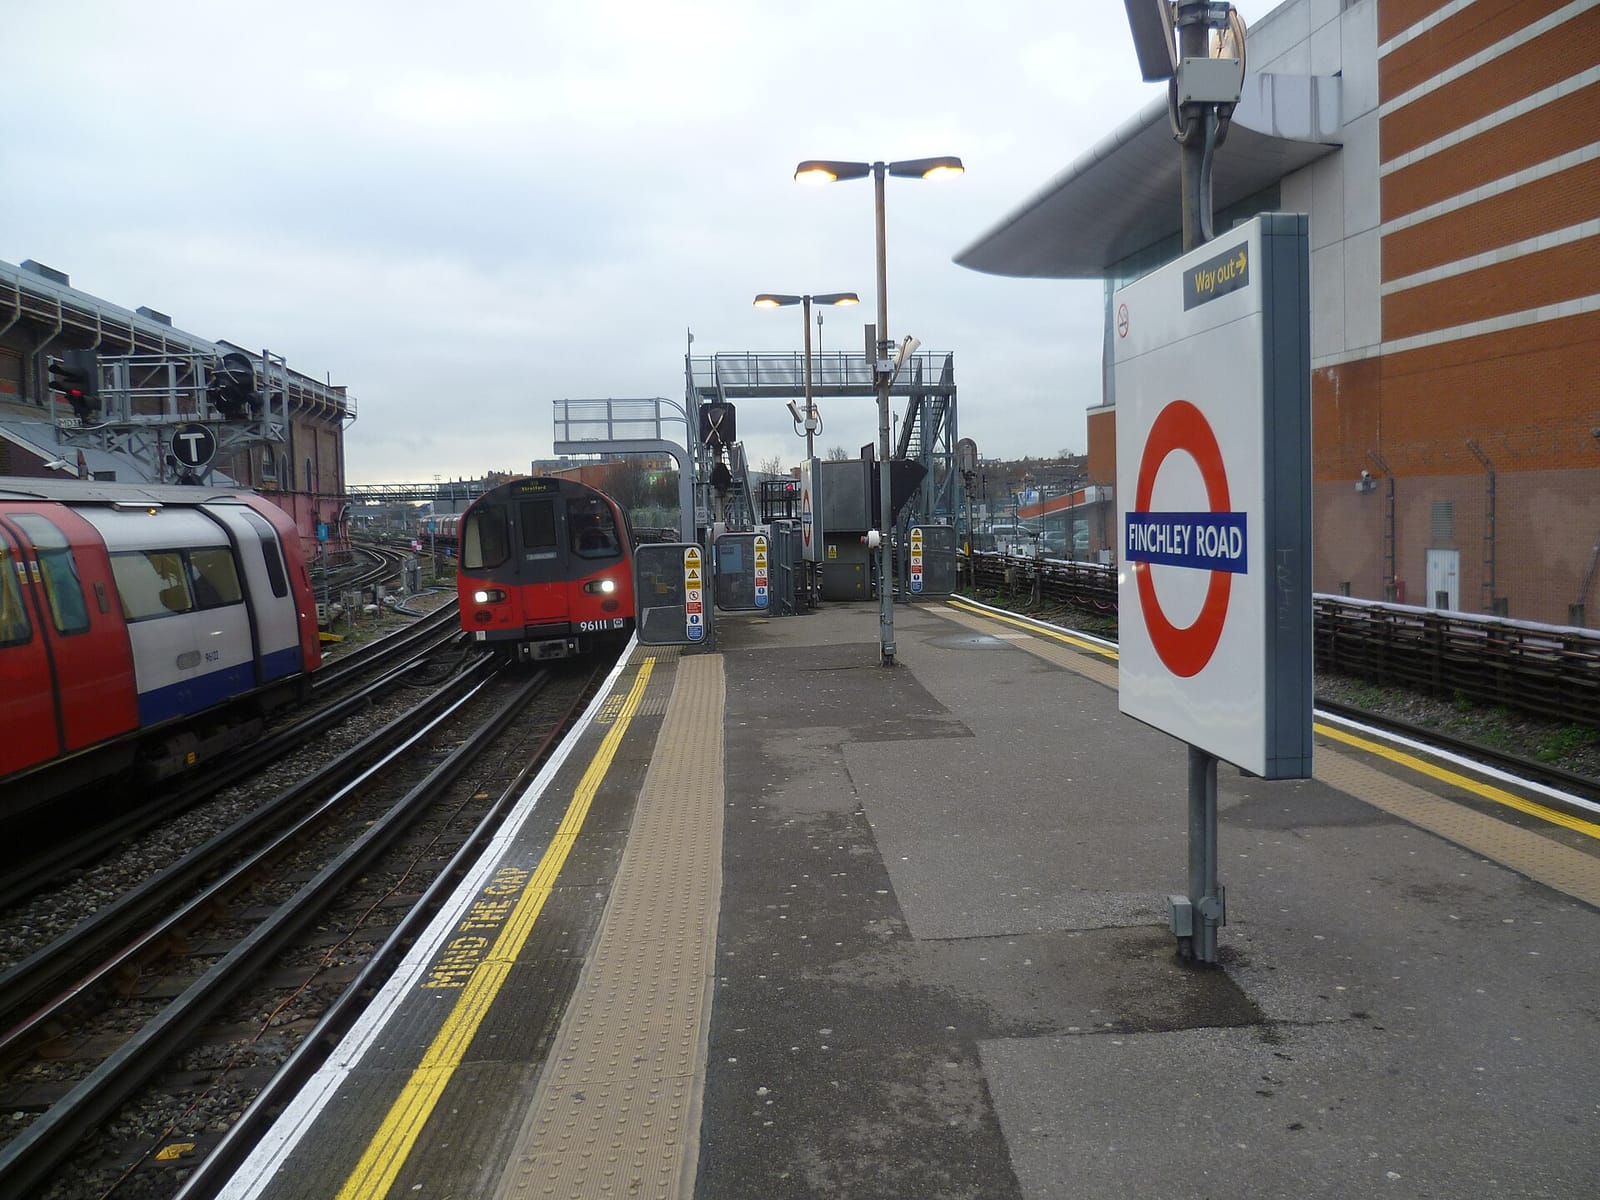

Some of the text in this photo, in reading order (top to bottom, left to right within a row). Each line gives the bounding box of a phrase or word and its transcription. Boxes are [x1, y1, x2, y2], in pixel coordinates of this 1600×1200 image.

[1195, 259, 1236, 293] Way out
[180, 433, 205, 462] T
[1128, 524, 1242, 559] FINCHLEY ROAD
[580, 620, 607, 631] 96111
[420, 867, 529, 988] MIND THE GAP
